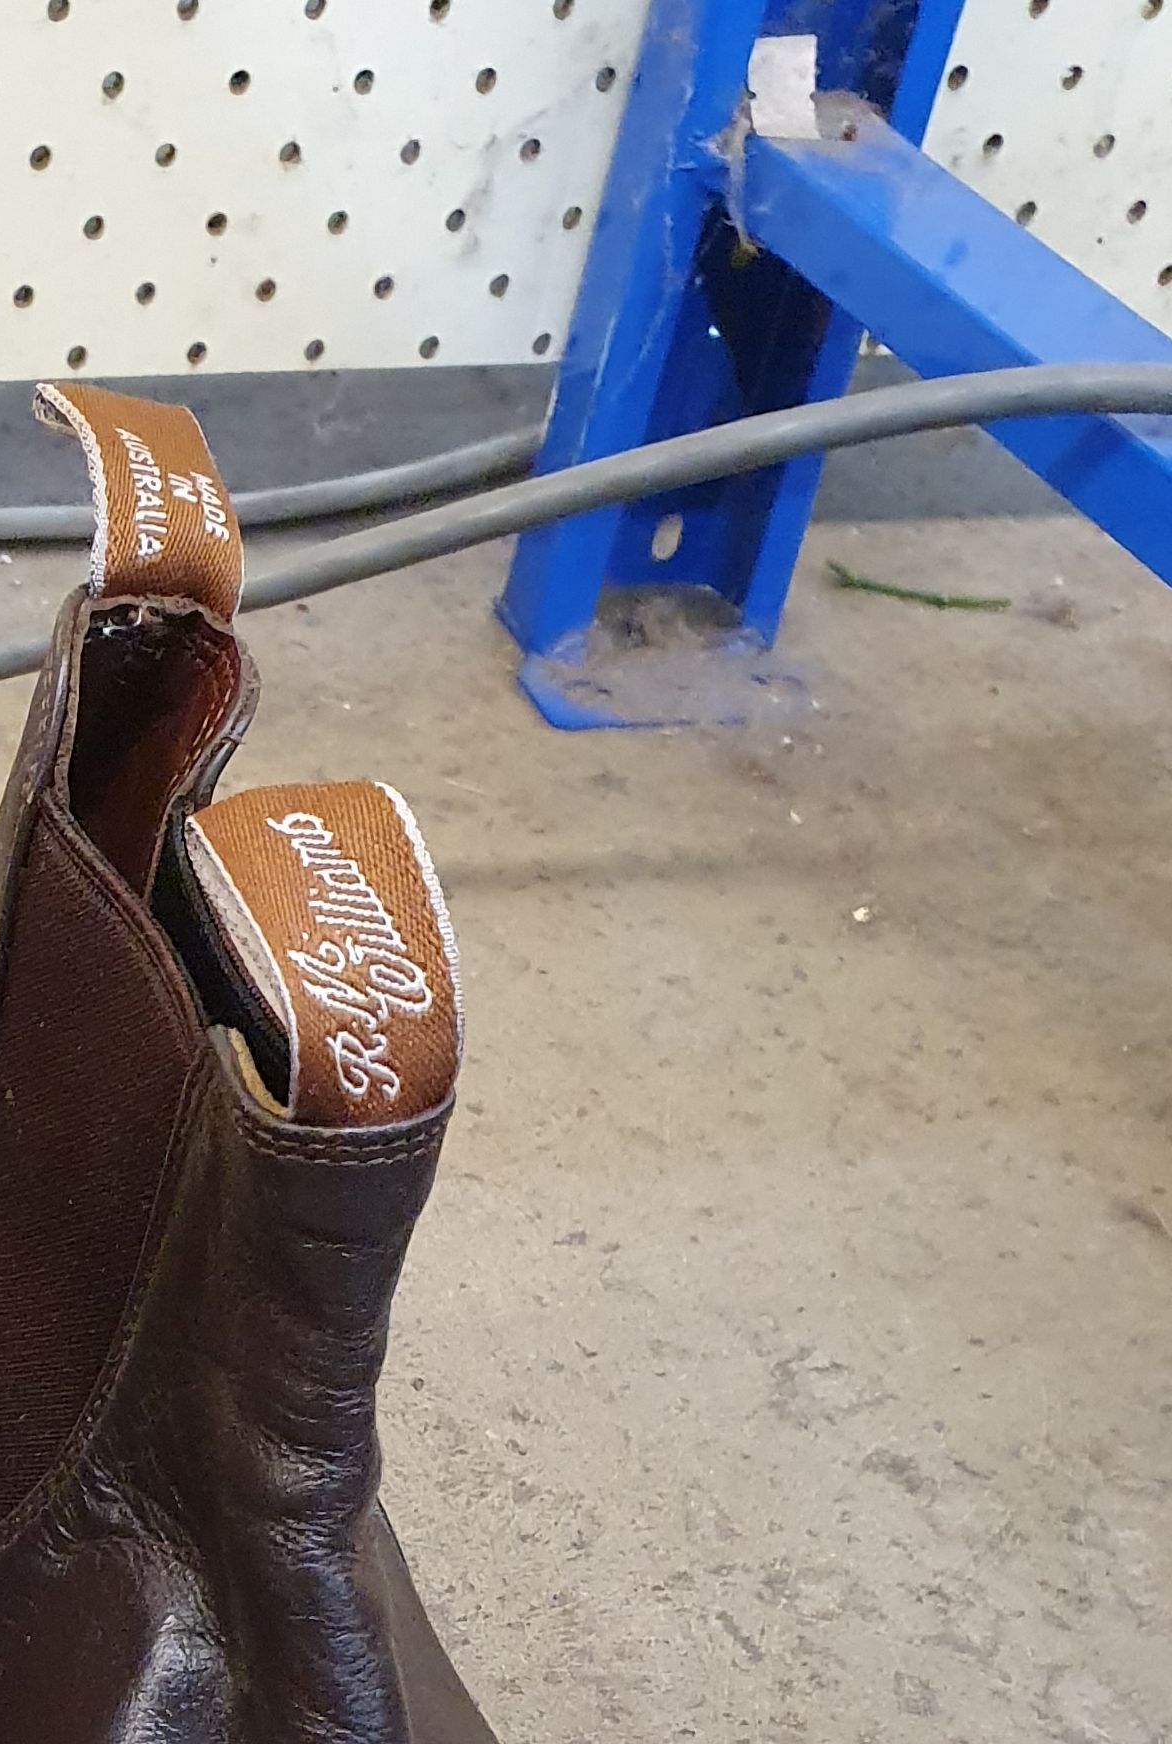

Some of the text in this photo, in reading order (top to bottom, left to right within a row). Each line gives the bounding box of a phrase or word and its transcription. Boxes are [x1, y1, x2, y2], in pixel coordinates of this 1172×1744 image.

[114, 427, 168, 557] AUSTRALIA
[168, 472, 198, 504] IN
[189, 471, 230, 541] MADE
